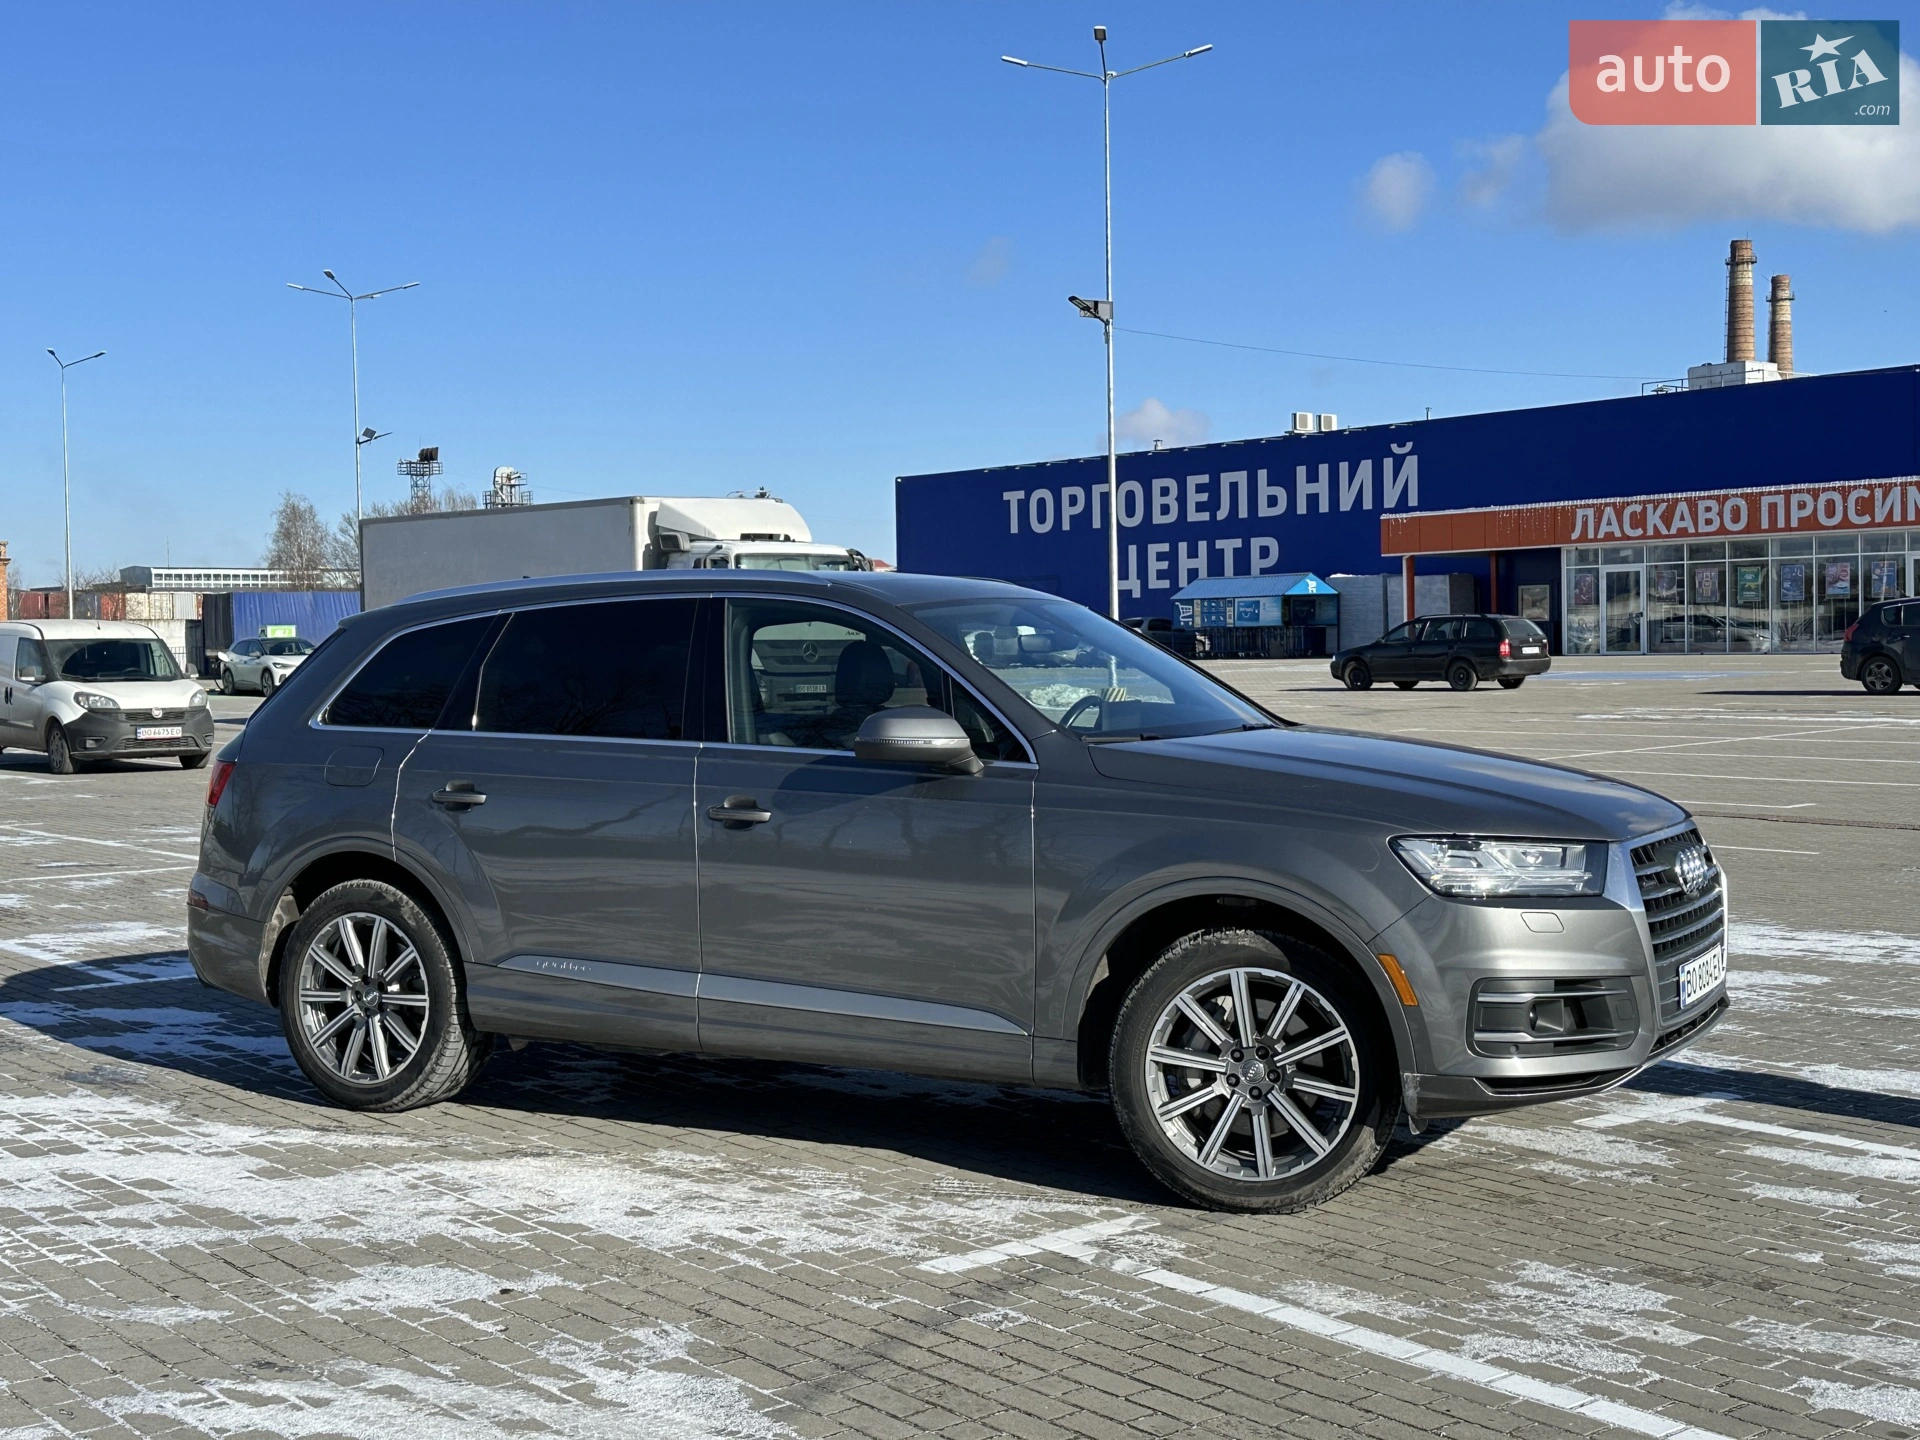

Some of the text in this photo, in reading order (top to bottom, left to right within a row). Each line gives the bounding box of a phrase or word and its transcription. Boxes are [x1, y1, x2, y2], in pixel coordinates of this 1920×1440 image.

[1002, 441, 1419, 534] ТОРГОВЕЛЬНИЙ
[1571, 497, 1749, 540] ЛАСКАВО
[1118, 536, 1280, 599] ЦЕНТР
